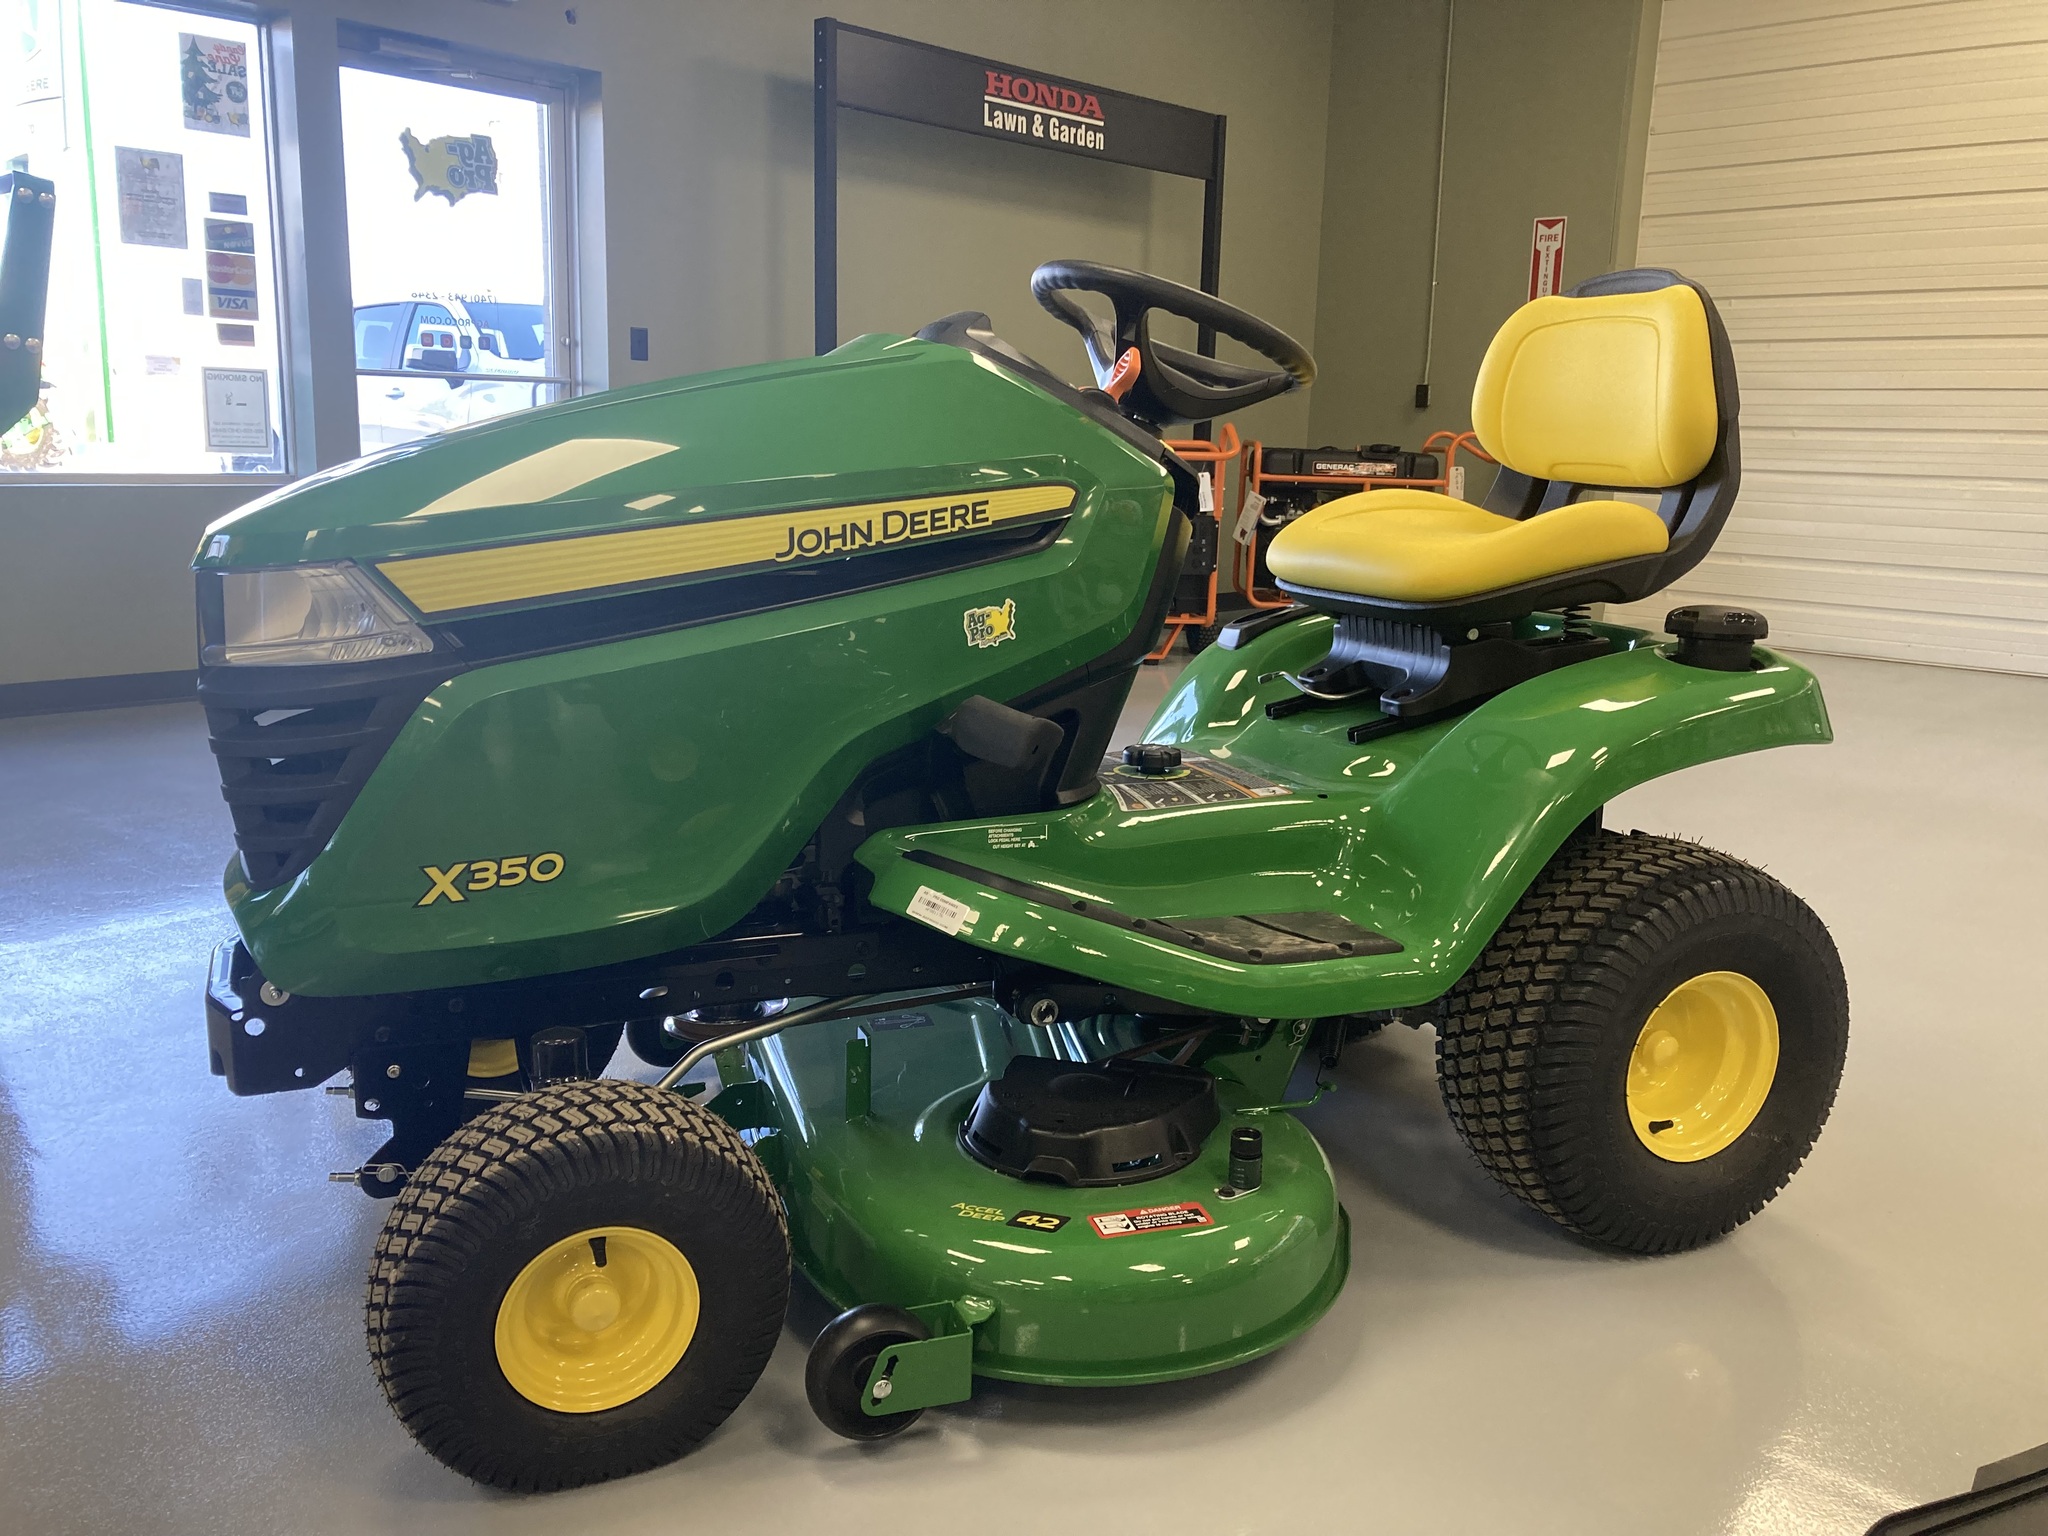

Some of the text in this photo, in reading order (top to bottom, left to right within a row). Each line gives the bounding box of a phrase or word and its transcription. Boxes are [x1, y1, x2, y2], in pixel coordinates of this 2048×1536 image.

[985, 71, 1105, 119] HONDA
[984, 103, 1104, 150] Lawn & Garden
[1539, 234, 1559, 242] FIRE
[1542, 246, 1551, 296] EXTINGU
[218, 296, 248, 310] VISA
[775, 500, 990, 558] JOHN DEERE
[970, 626, 994, 642] Pro
[418, 853, 565, 906] X350
[951, 1202, 1004, 1215] ACCEL
[1148, 1205, 1181, 1213] DANGER
[958, 1210, 1060, 1229] DEEP 42
